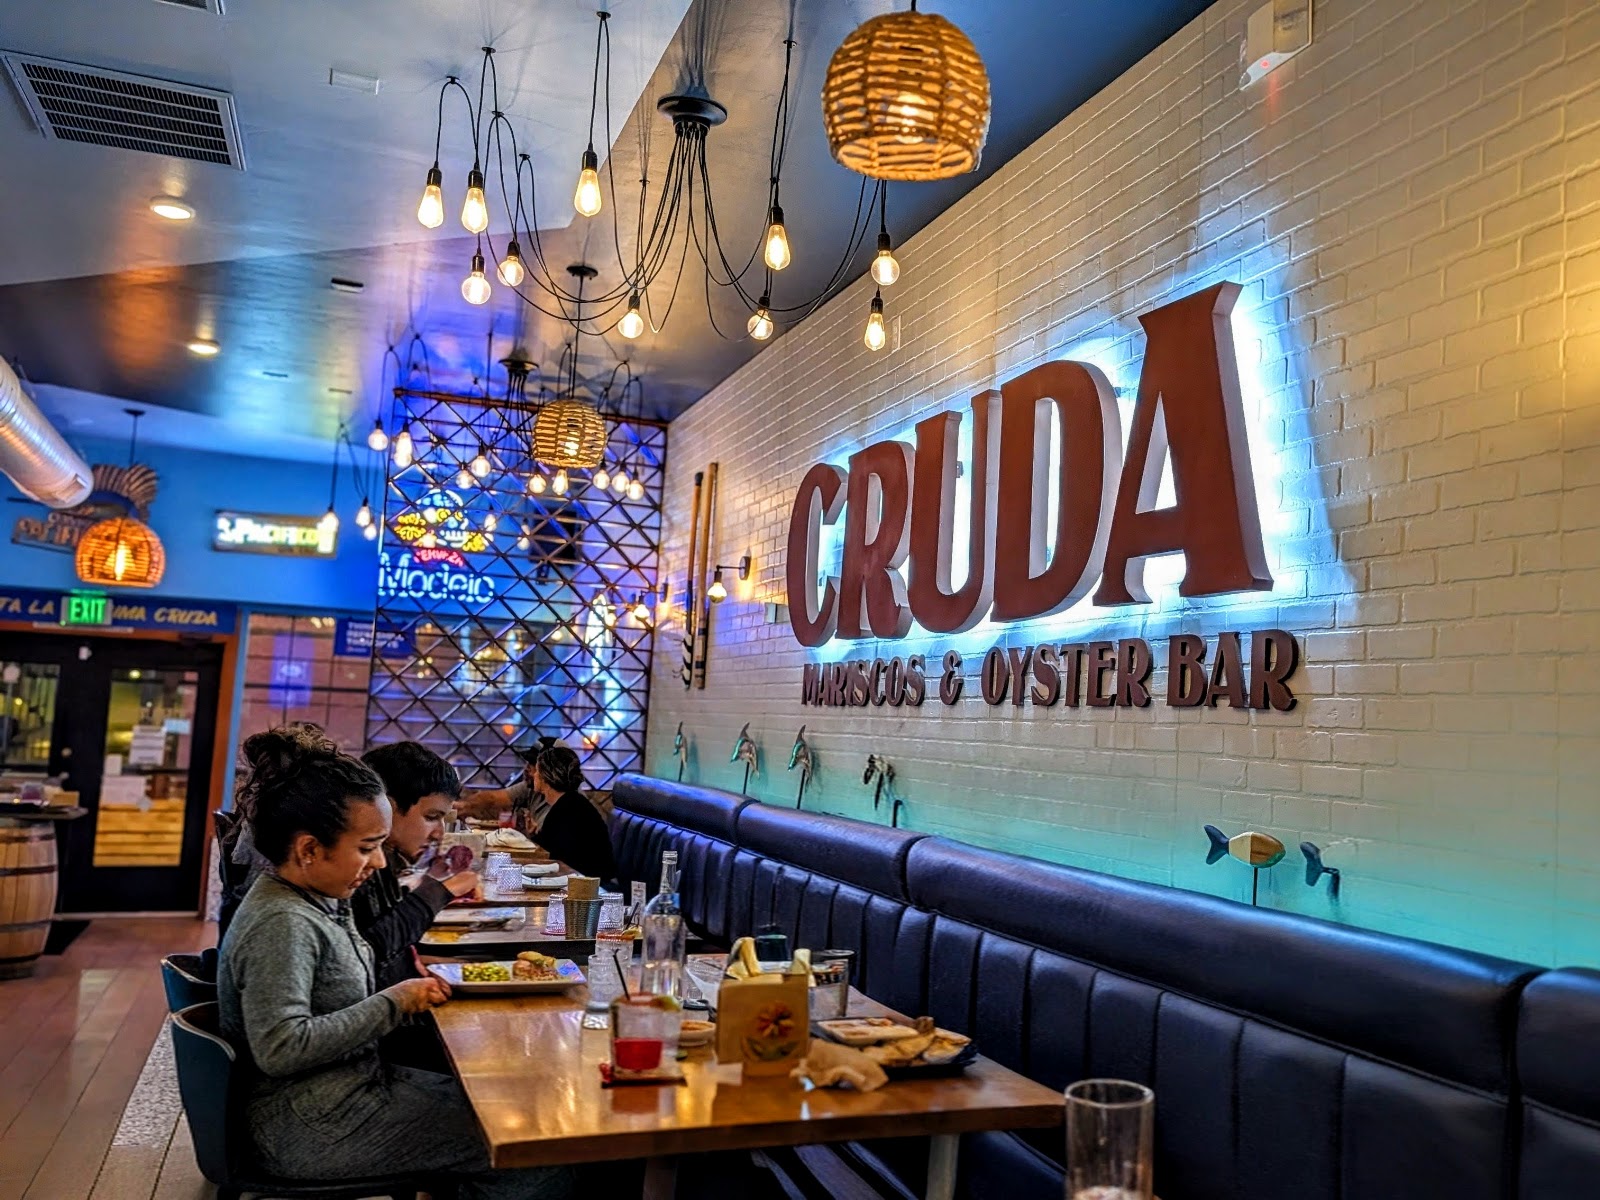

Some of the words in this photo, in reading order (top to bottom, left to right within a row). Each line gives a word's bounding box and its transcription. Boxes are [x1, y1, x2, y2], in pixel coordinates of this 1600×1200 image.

[787, 282, 1273, 647] CRUDA
[28, 600, 54, 615] LA
[154, 607, 218, 626] CRUDA
[70, 597, 106, 624] EXIT
[802, 654, 925, 707] MARISCOS
[939, 650, 963, 706] &
[981, 638, 1153, 708] OYSTER
[1166, 629, 1298, 711] BAR
